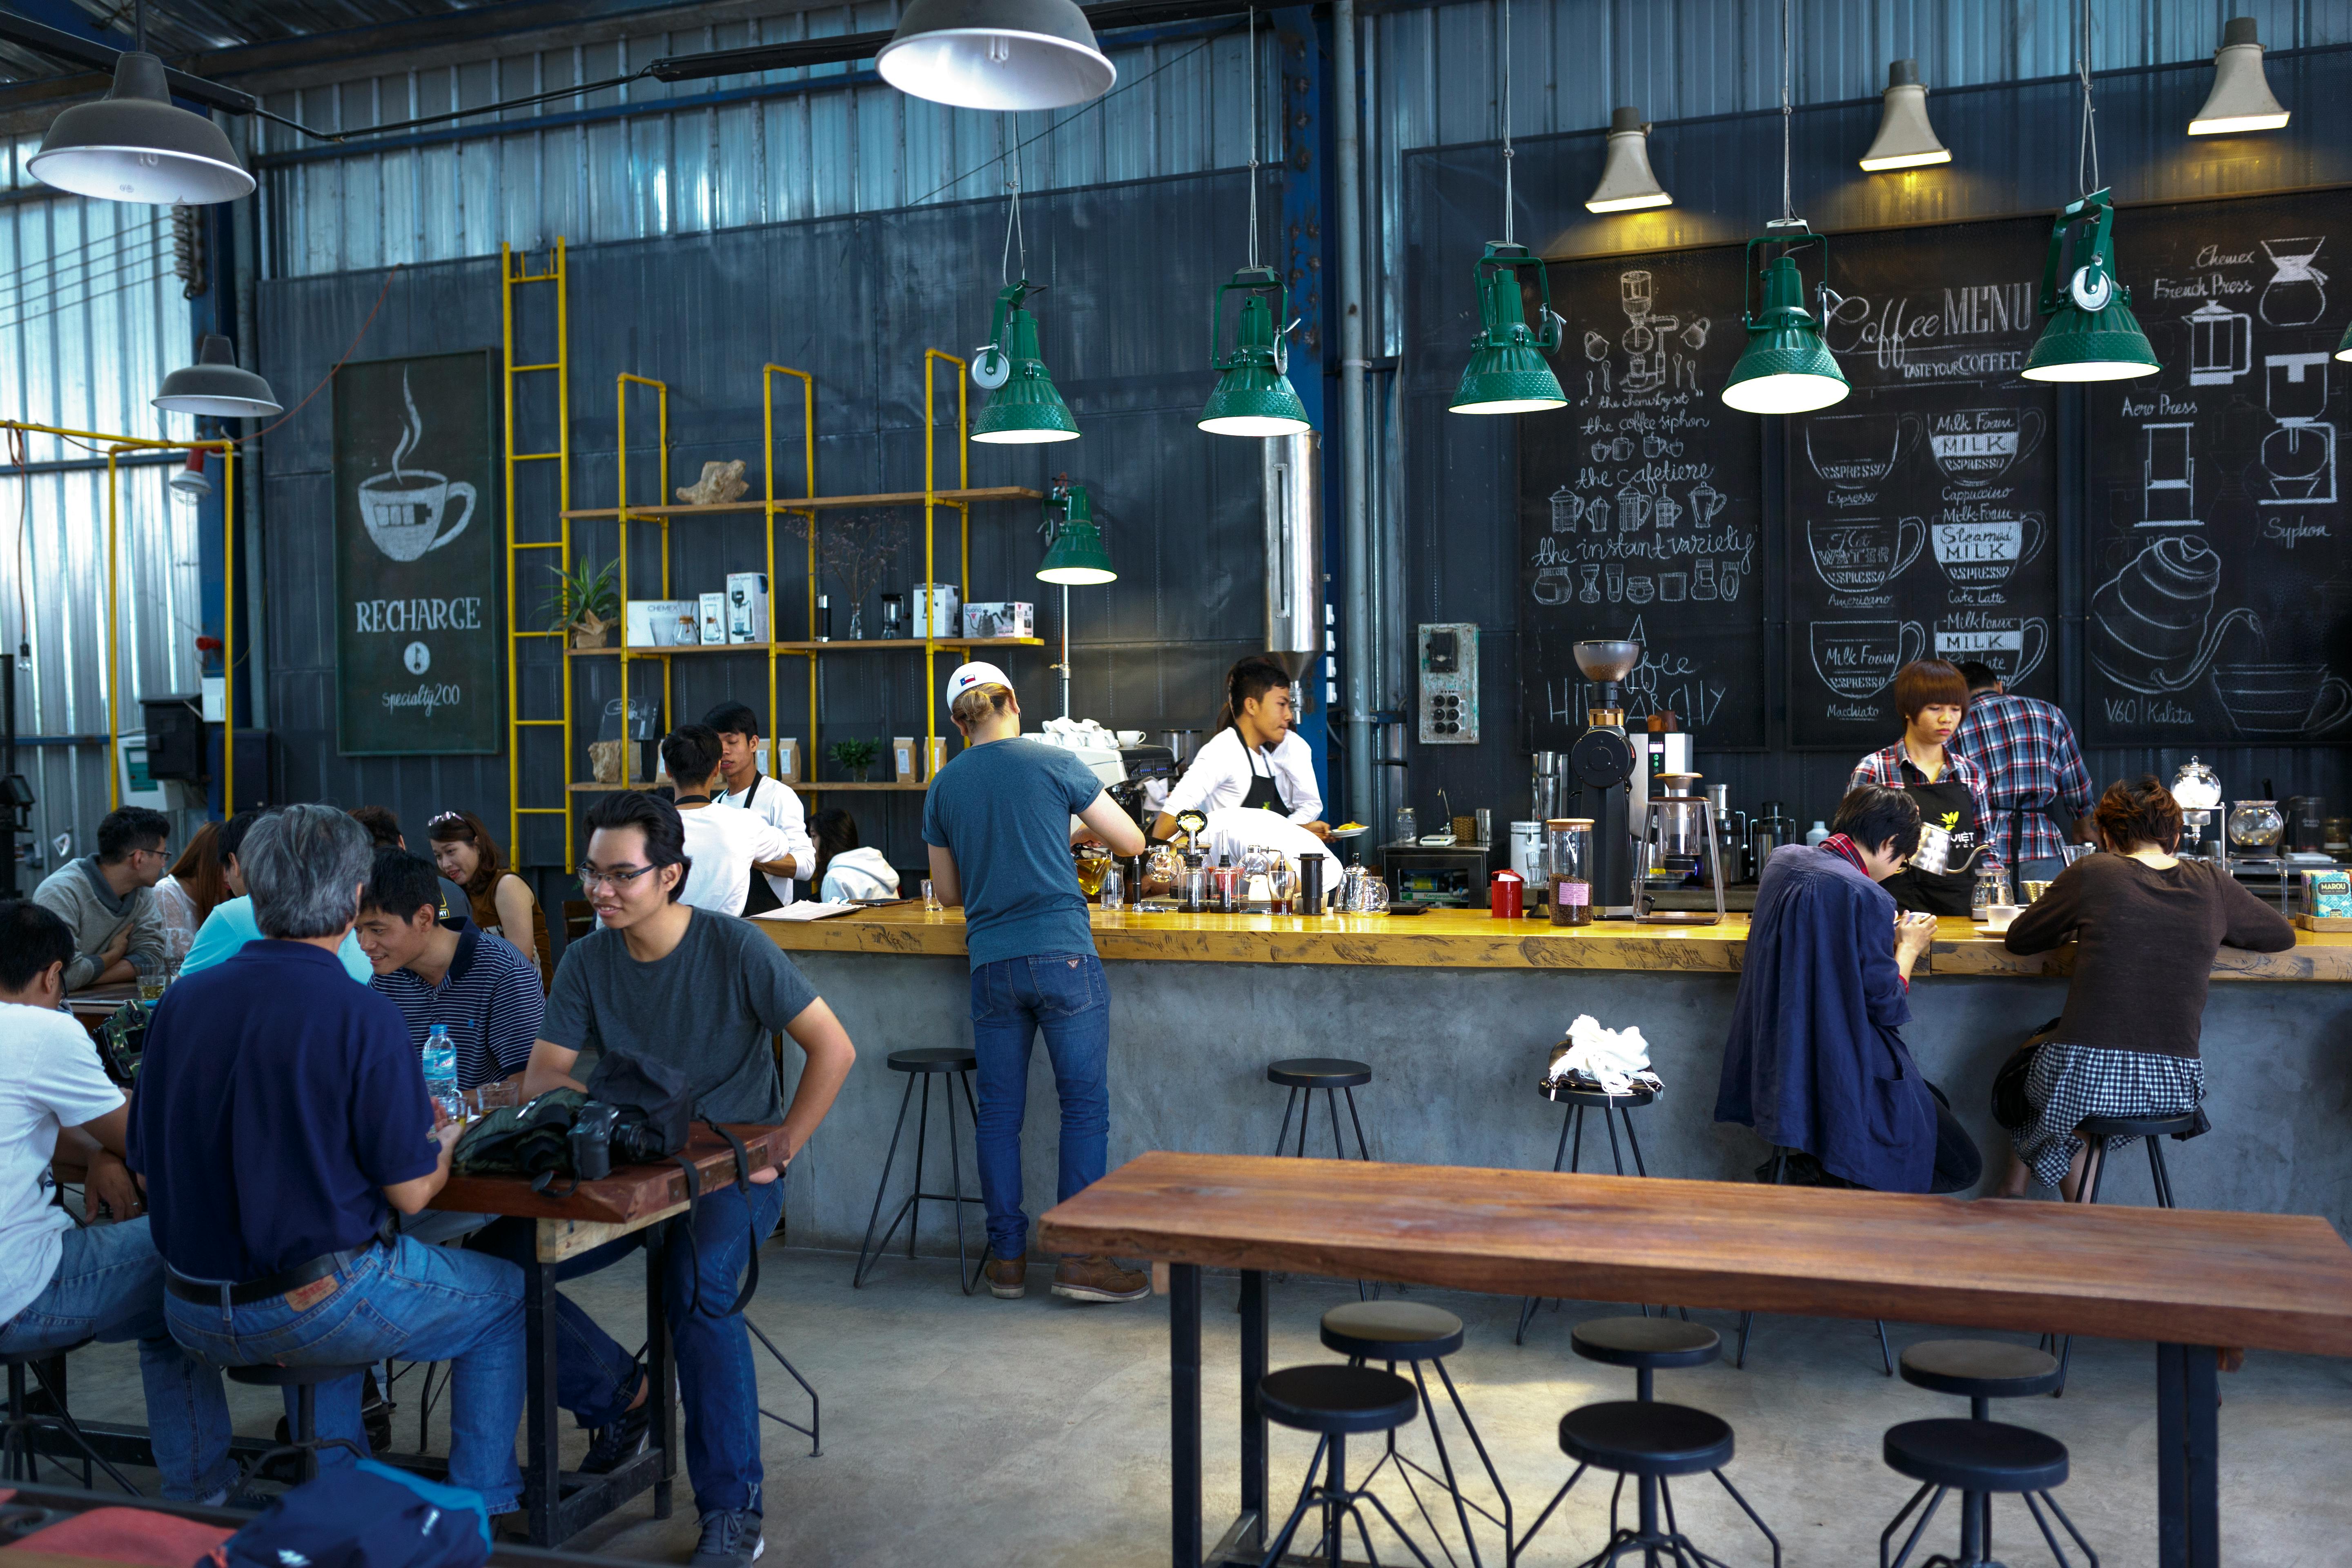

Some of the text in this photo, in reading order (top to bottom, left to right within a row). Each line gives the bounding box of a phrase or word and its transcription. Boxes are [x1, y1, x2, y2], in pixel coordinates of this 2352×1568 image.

[2196, 244, 2255, 268] Chemex
[2154, 271, 2255, 300] French Press
[1822, 282, 2031, 370] Coffee MENU
[1904, 350, 2022, 378] TASTE YOUR COFFEE
[1598, 395, 1621, 409] the
[2121, 393, 2198, 417] Aero Press
[1580, 408, 1711, 435] the coffee siphon
[1936, 412, 2015, 432] Milk Foam
[1943, 435, 2007, 453] MILK
[1821, 463, 1886, 479] ESPRESSO
[1944, 457, 2005, 471] ESPRESSO
[1575, 460, 1715, 495] the cafetiere
[1827, 490, 1878, 509] Espresso
[1942, 485, 2016, 506] Cappuccino
[1943, 505, 1978, 523] Milk
[1531, 524, 1755, 575] the instant variety
[1816, 546, 1889, 566] WATER
[1946, 542, 2006, 560] MILK
[1826, 570, 1886, 584] ESPRESSO
[1949, 566, 2009, 580] ESPRESSO
[1828, 593, 1893, 606] Americano
[1978, 590, 2007, 604] Latte
[355, 597, 481, 633] RECHARGE
[648, 604, 679, 612] CHEMEX
[1947, 610, 1981, 630] Milk
[1628, 613, 1647, 648] A
[1947, 635, 2004, 650] MILK
[1825, 644, 1895, 666] Milk Foam
[1829, 676, 1886, 688] ESPRESSO
[1827, 702, 1880, 718] Macchiato
[2105, 697, 2195, 724] V60 Kalita
